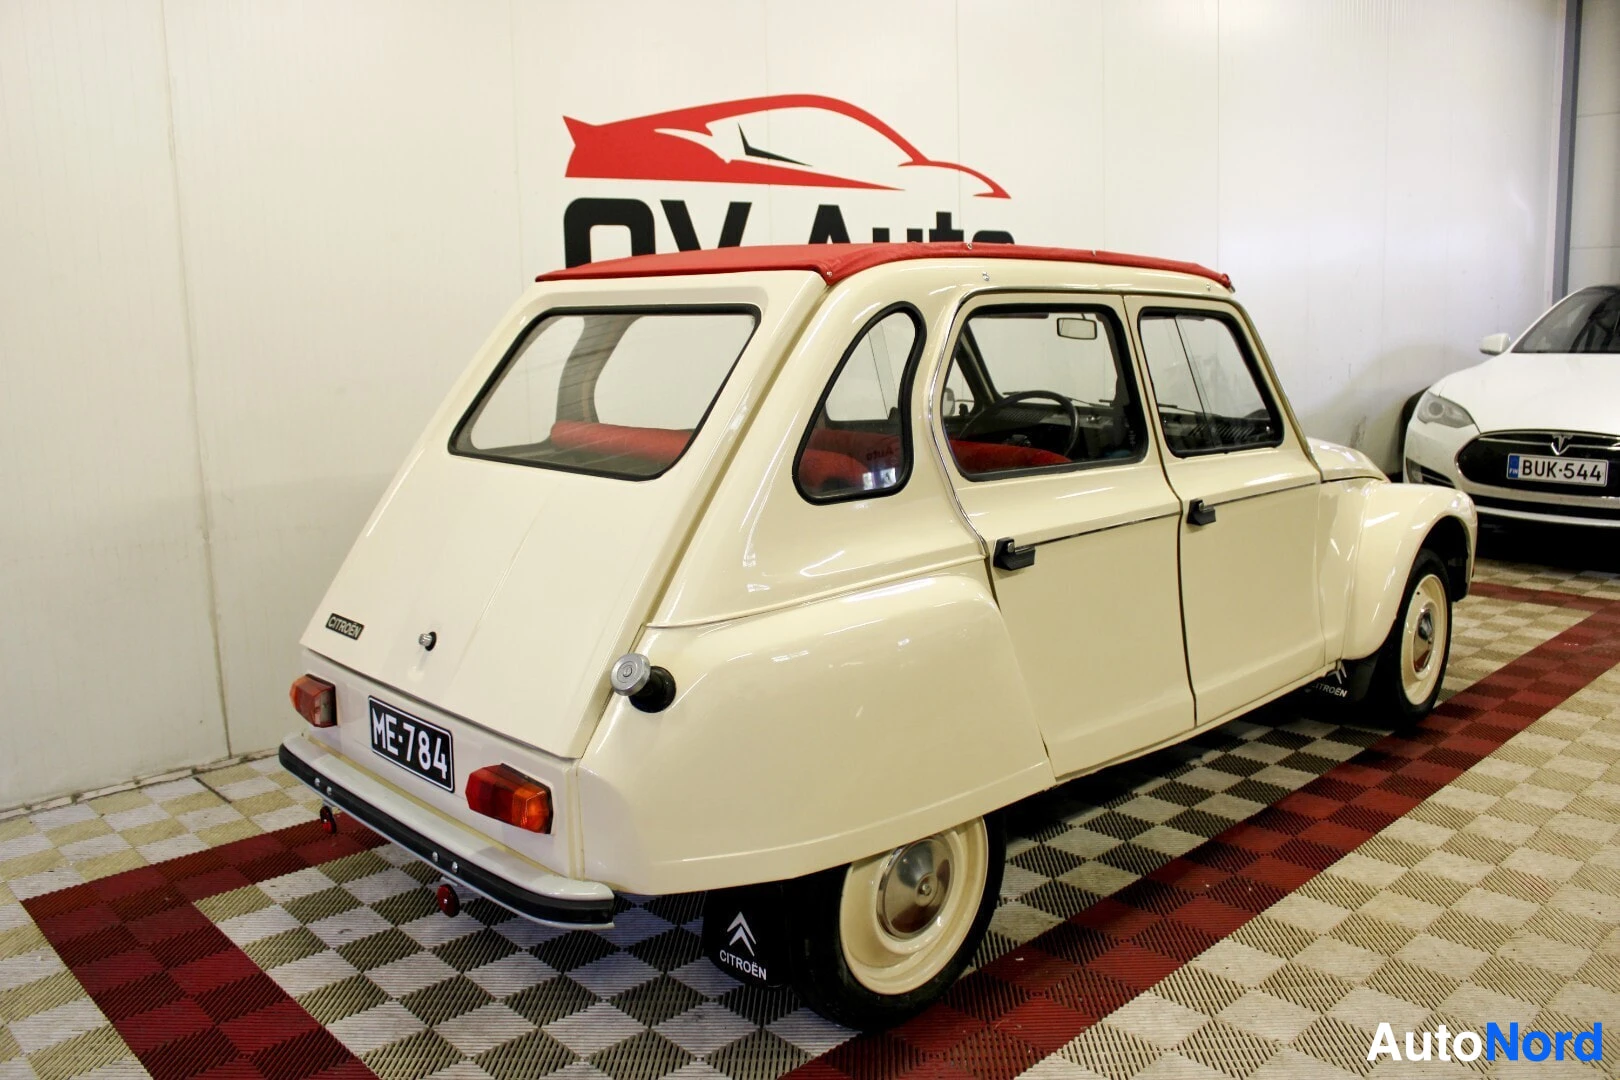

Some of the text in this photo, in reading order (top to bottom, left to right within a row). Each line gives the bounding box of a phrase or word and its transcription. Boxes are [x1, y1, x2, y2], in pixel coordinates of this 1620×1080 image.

[1522, 460, 1602, 481] BUK-544
[371, 707, 447, 780] ME-784
[720, 949, 767, 981] CITROËN
